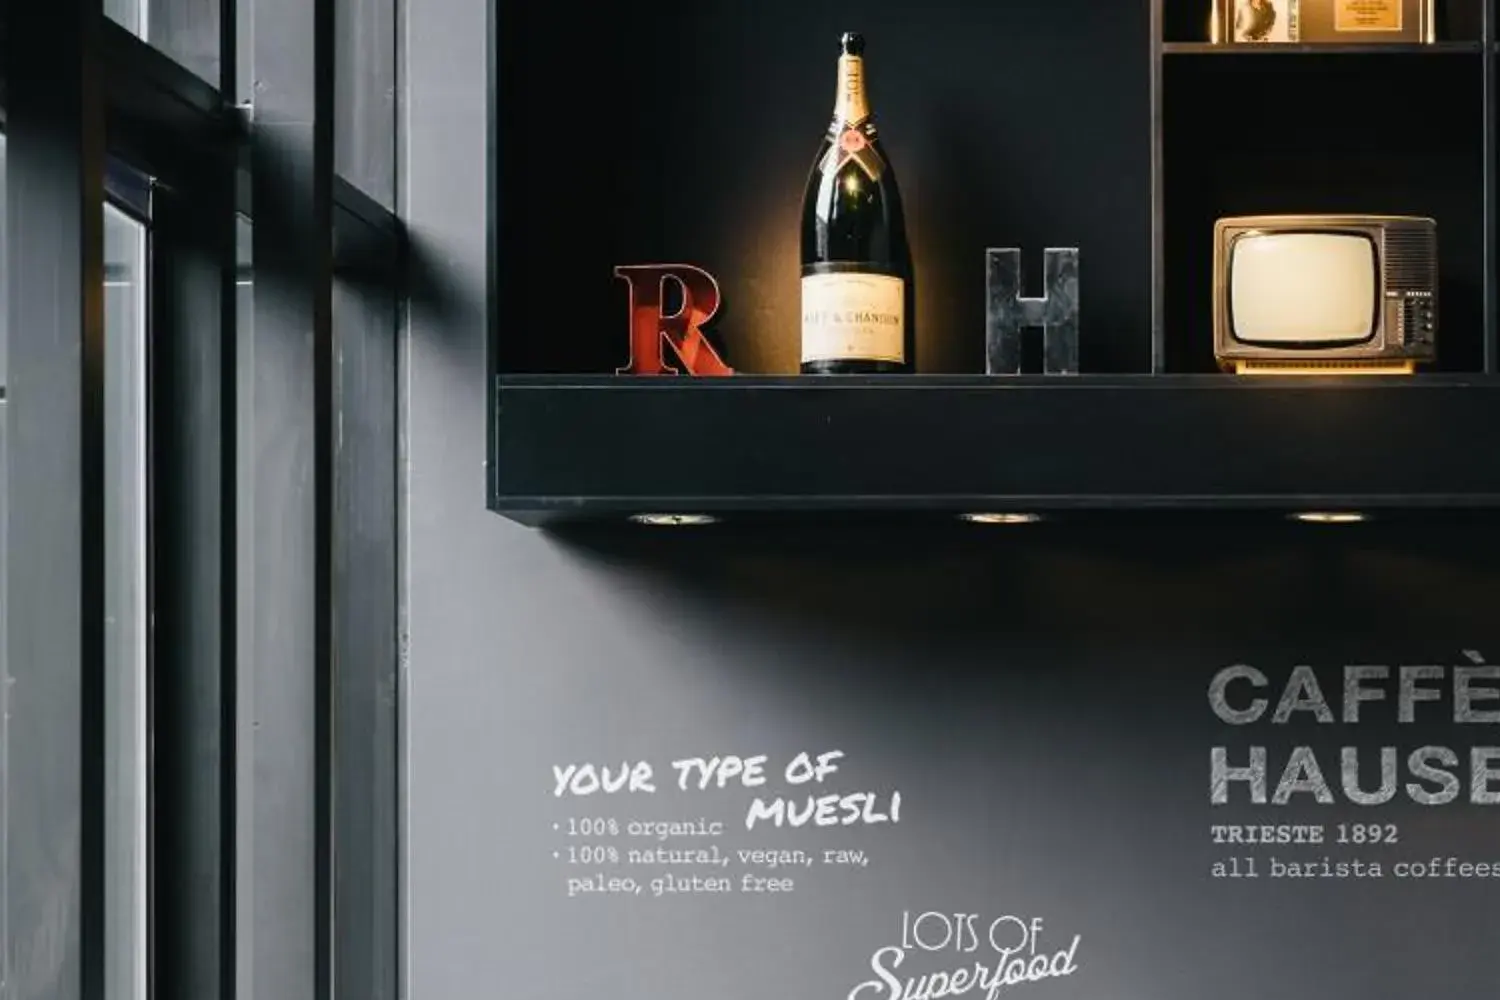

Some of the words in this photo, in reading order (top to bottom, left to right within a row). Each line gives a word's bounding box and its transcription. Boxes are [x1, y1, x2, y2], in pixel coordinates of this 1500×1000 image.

[615, 264, 734, 376] R
[986, 247, 1079, 375] H
[553, 761, 656, 796] YOUR
[672, 755, 767, 790] TYPE
[785, 750, 844, 783] OF
[746, 791, 901, 829] MUESLI
[568, 818, 619, 835] 100%
[628, 818, 722, 840] organic
[1211, 825, 1323, 843] TRIESTE
[1337, 824, 1397, 843] 1892
[569, 846, 619, 863] 100%
[629, 845, 729, 866] natural,
[737, 850, 813, 868] vegan,
[824, 850, 868, 866] raw,
[1212, 857, 1258, 877] all
[1271, 857, 1383, 877] barista
[568, 873, 642, 896] paleo,
[650, 874, 731, 896] gluten
[741, 874, 794, 892] free
[902, 911, 978, 951] LOTS
[989, 915, 1043, 955] OF
